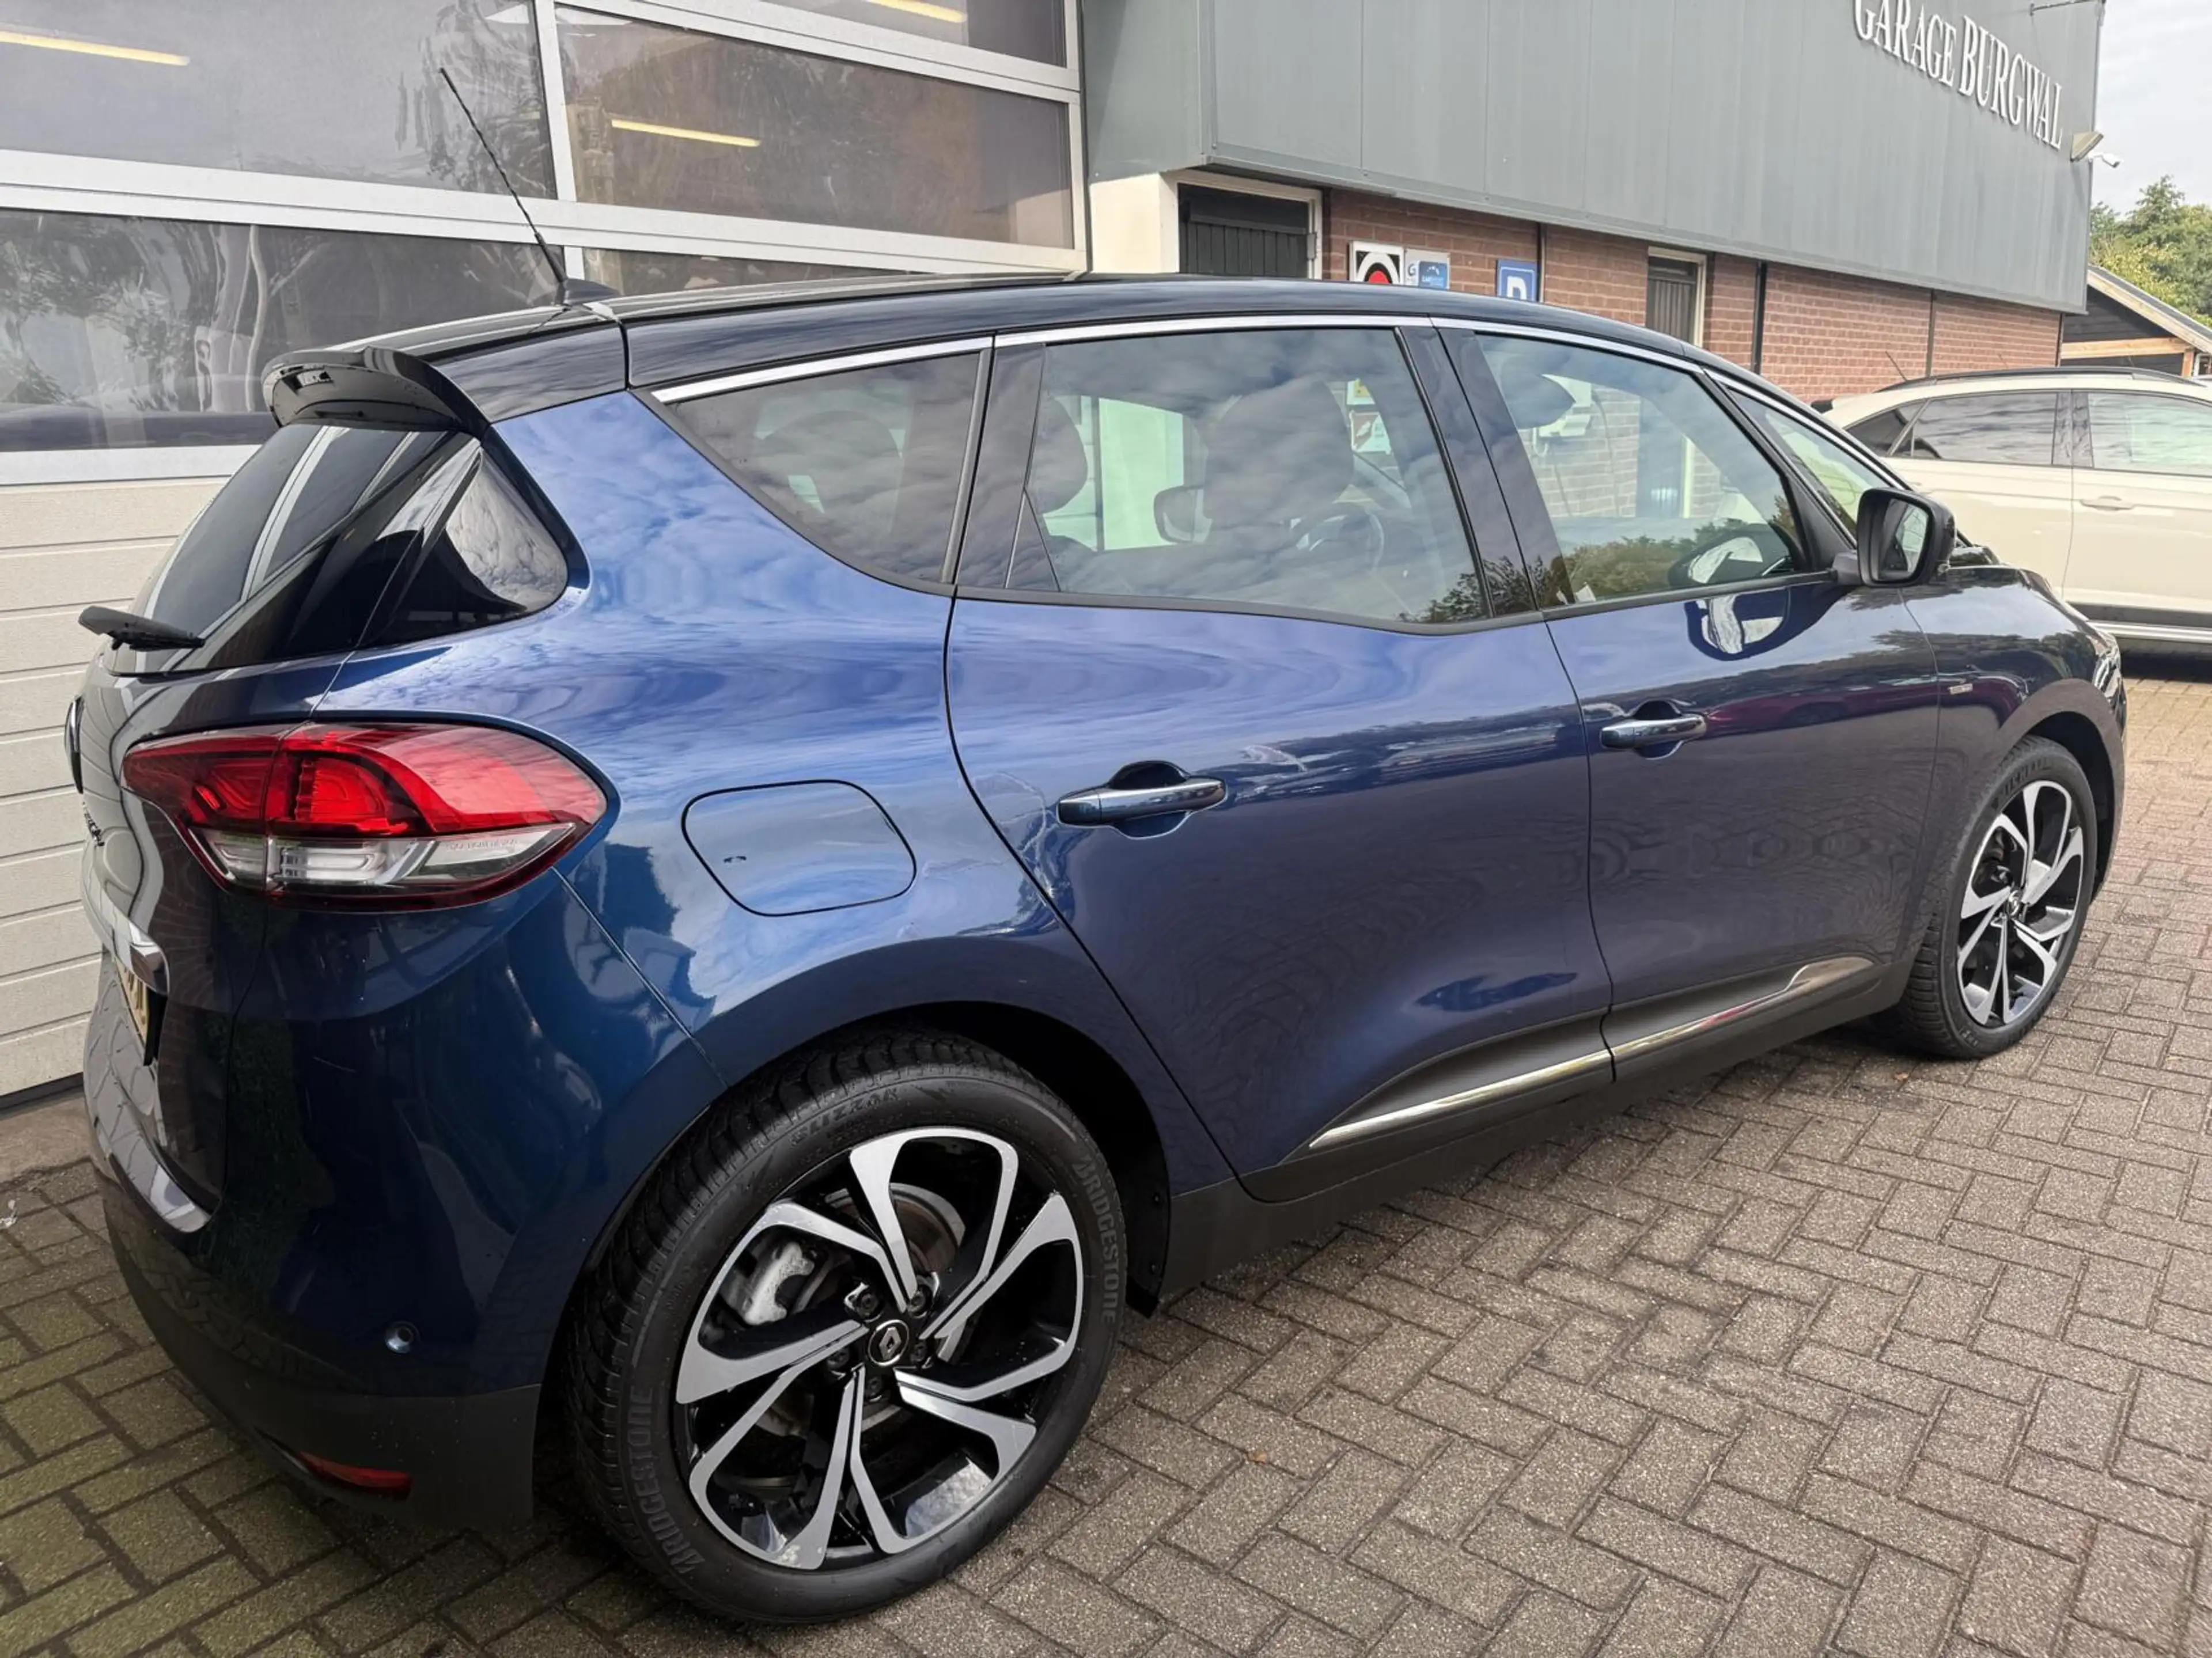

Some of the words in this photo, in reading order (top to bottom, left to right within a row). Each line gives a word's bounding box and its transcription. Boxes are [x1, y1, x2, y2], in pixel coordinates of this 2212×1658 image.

[1853, 0, 1956, 87] GARAGE
[1959, 16, 2062, 149] BURGWAL
[1071, 1152, 1120, 1324] BRIDGESTONE
[628, 1387, 706, 1574] BRIDGESTONE
